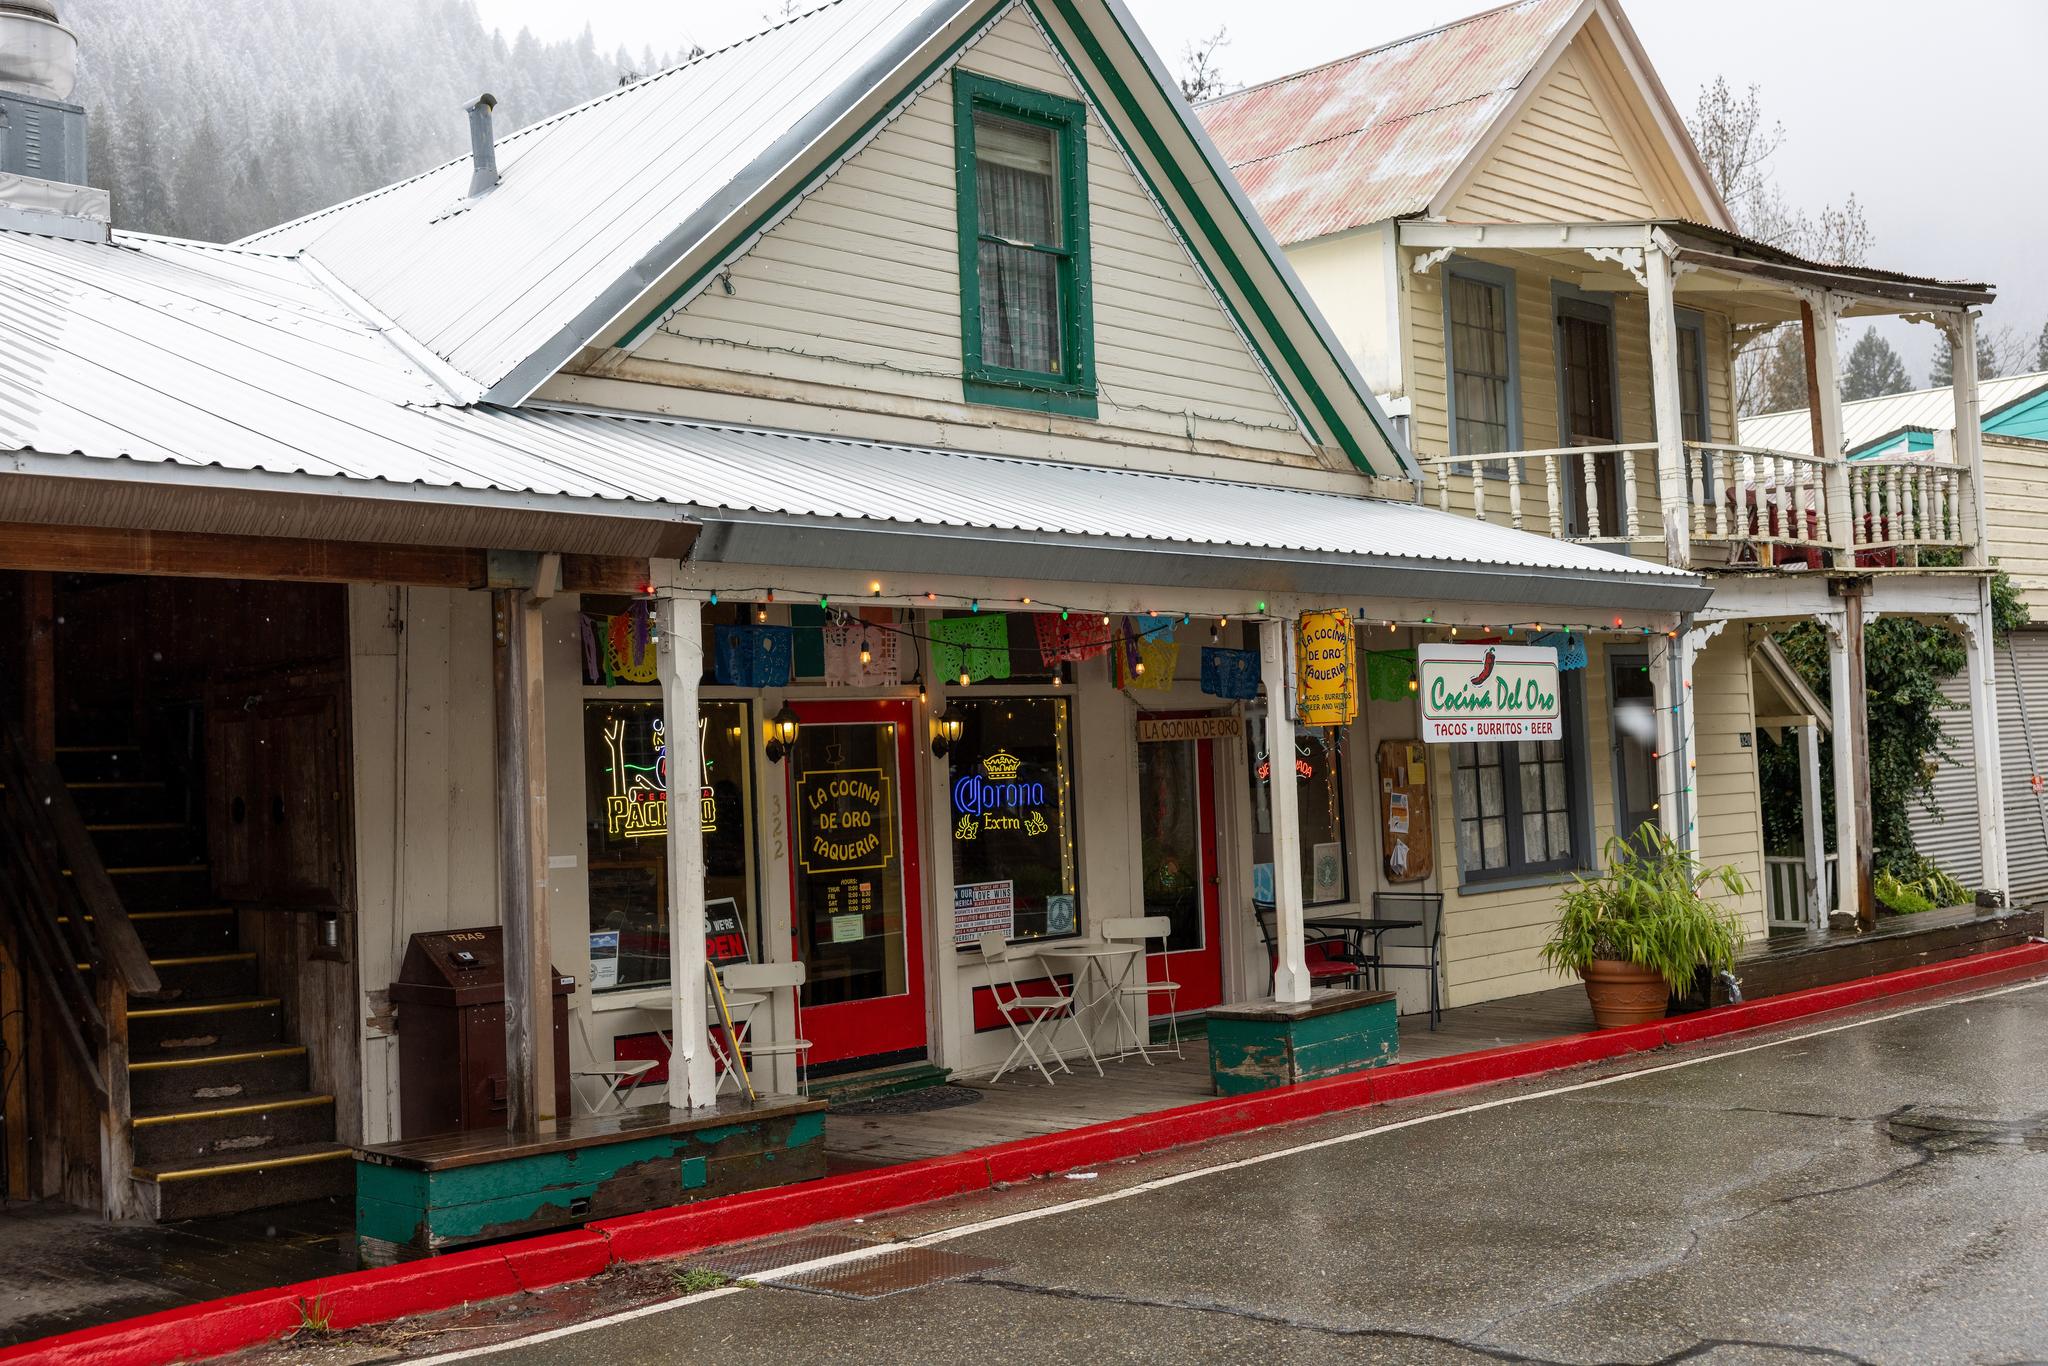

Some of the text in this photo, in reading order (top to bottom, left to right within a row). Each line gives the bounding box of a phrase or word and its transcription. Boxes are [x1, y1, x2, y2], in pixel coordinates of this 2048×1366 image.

[1302, 628, 1346, 649] LA COCINA
[1308, 648, 1341, 661] DE ORO
[1304, 662, 1346, 680] TAQUERIA
[1431, 675, 1555, 712] Cocina Del Oro
[1144, 719, 1239, 739] LA COCINA DE ORO
[1434, 722, 1553, 737] TACOS BURRITOS BEER
[808, 779, 881, 810] LA COCINA
[954, 774, 1044, 816] Corona
[772, 794, 784, 861] 322
[819, 810, 871, 830] DE ORO
[983, 812, 1020, 830] Extra
[813, 833, 880, 861] TAQUERIA
[960, 889, 973, 899] OUR
[974, 888, 1011, 901] LOVE WINS
[713, 918, 735, 931] WE'RE
[447, 932, 485, 942] TRAS
[705, 932, 745, 960] PEN
